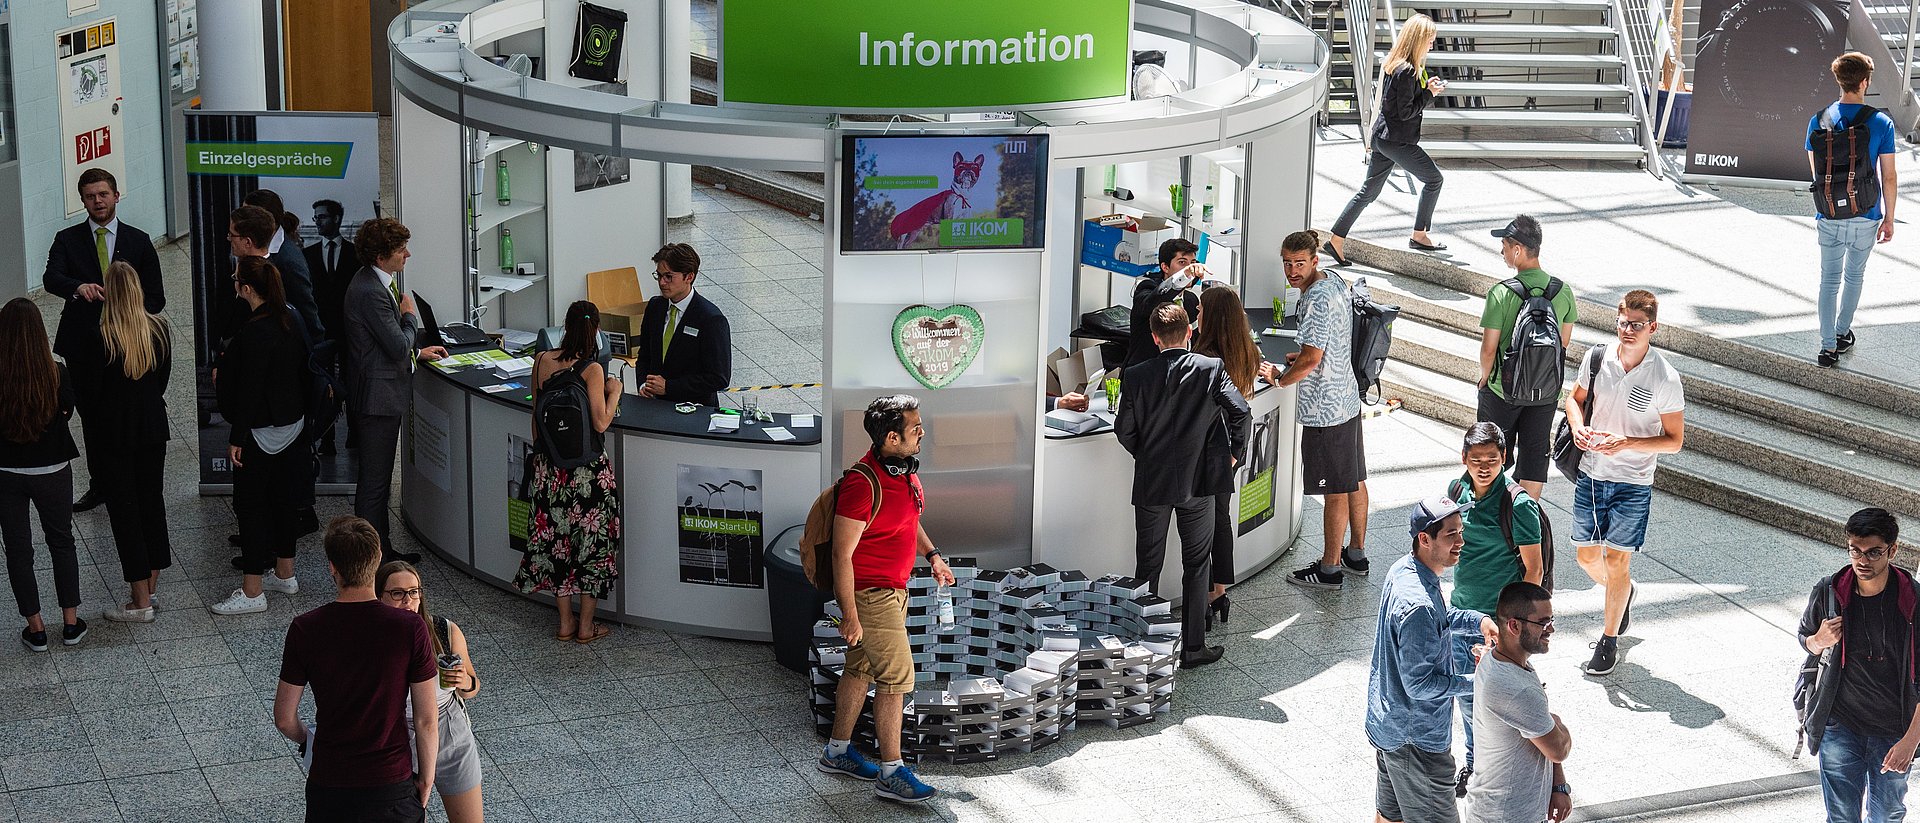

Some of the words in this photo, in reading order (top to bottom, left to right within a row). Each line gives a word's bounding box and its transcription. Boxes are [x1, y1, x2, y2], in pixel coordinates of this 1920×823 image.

[859, 28, 1094, 67] Information
[199, 151, 332, 169] Einzelgespräche
[1708, 154, 1739, 168] IKOM
[969, 221, 1008, 236] IKOM
[911, 327, 961, 339] Willkommen
[916, 338, 932, 350] auf
[936, 338, 951, 348] der
[925, 361, 949, 373] 2019
[695, 518, 718, 530] IKOM
[720, 521, 757, 534] Start-Up
